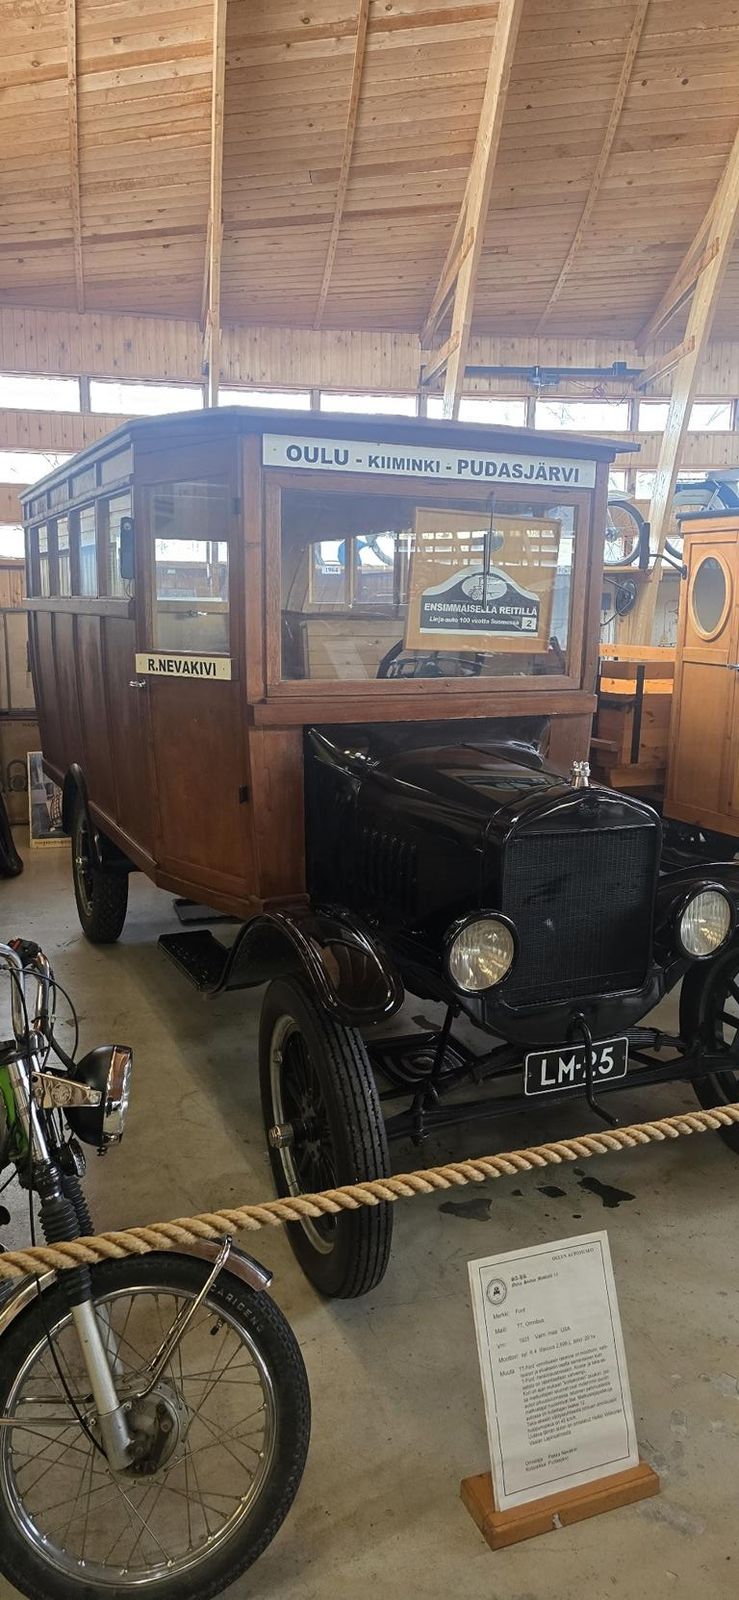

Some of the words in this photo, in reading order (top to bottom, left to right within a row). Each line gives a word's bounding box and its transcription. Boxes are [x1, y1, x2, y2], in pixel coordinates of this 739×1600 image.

[286, 444, 349, 466] OULU
[368, 455, 440, 473] KIIMINKI
[457, 459, 579, 483] PUDASJÄRVI
[526, 620, 532, 628] 2
[147, 658, 217, 676] R.NEVAKIVI
